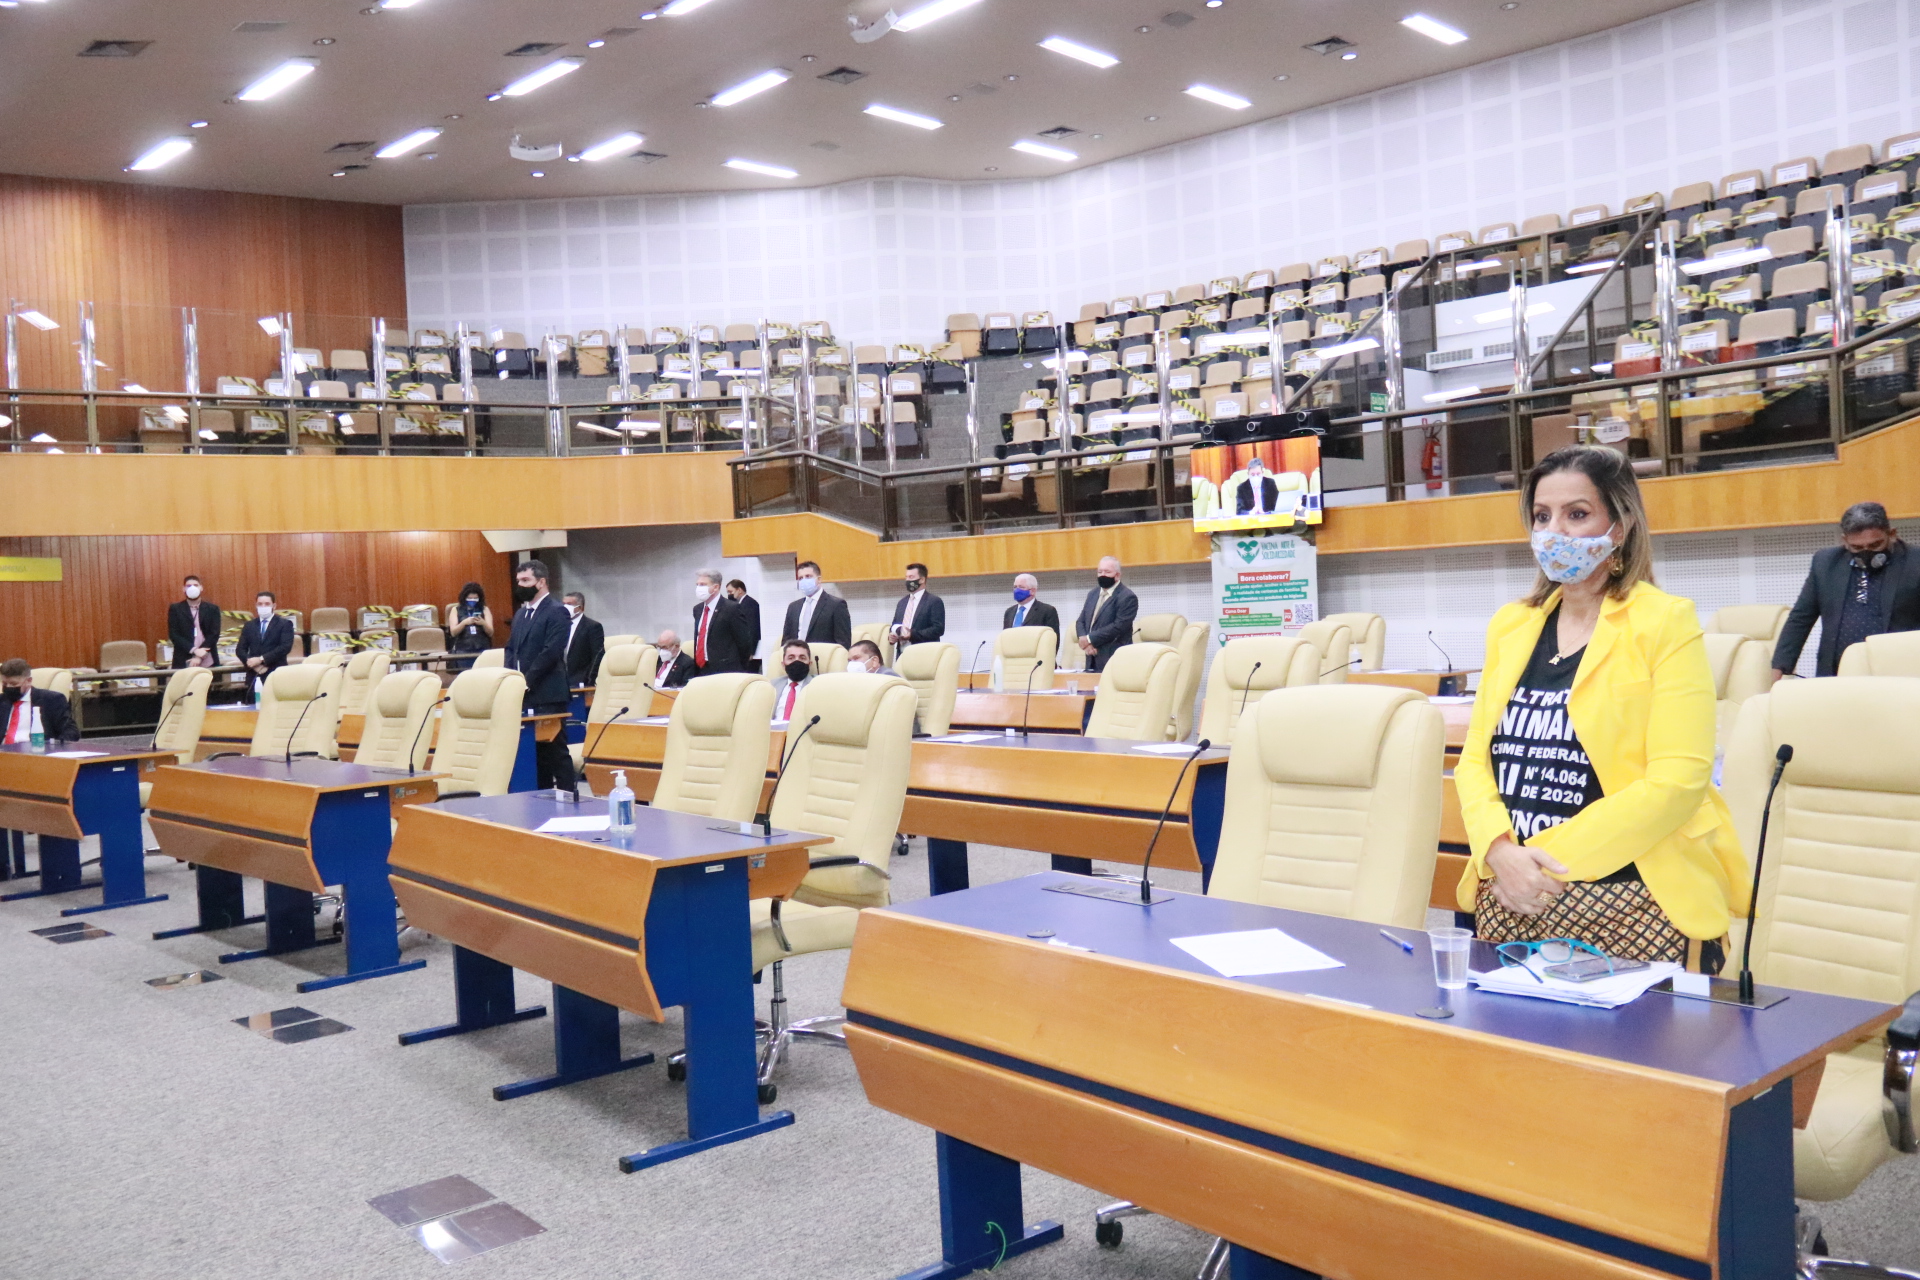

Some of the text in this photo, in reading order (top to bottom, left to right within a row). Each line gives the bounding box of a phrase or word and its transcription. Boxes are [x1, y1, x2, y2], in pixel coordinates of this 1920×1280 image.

[1256, 573, 1289, 581] colaborar?
[1510, 687, 1571, 706] LTRAT
[1528, 746, 1589, 764] FEDERAL
[1541, 766, 1588, 788] 14.064
[1520, 784, 1584, 806] DE 2020
